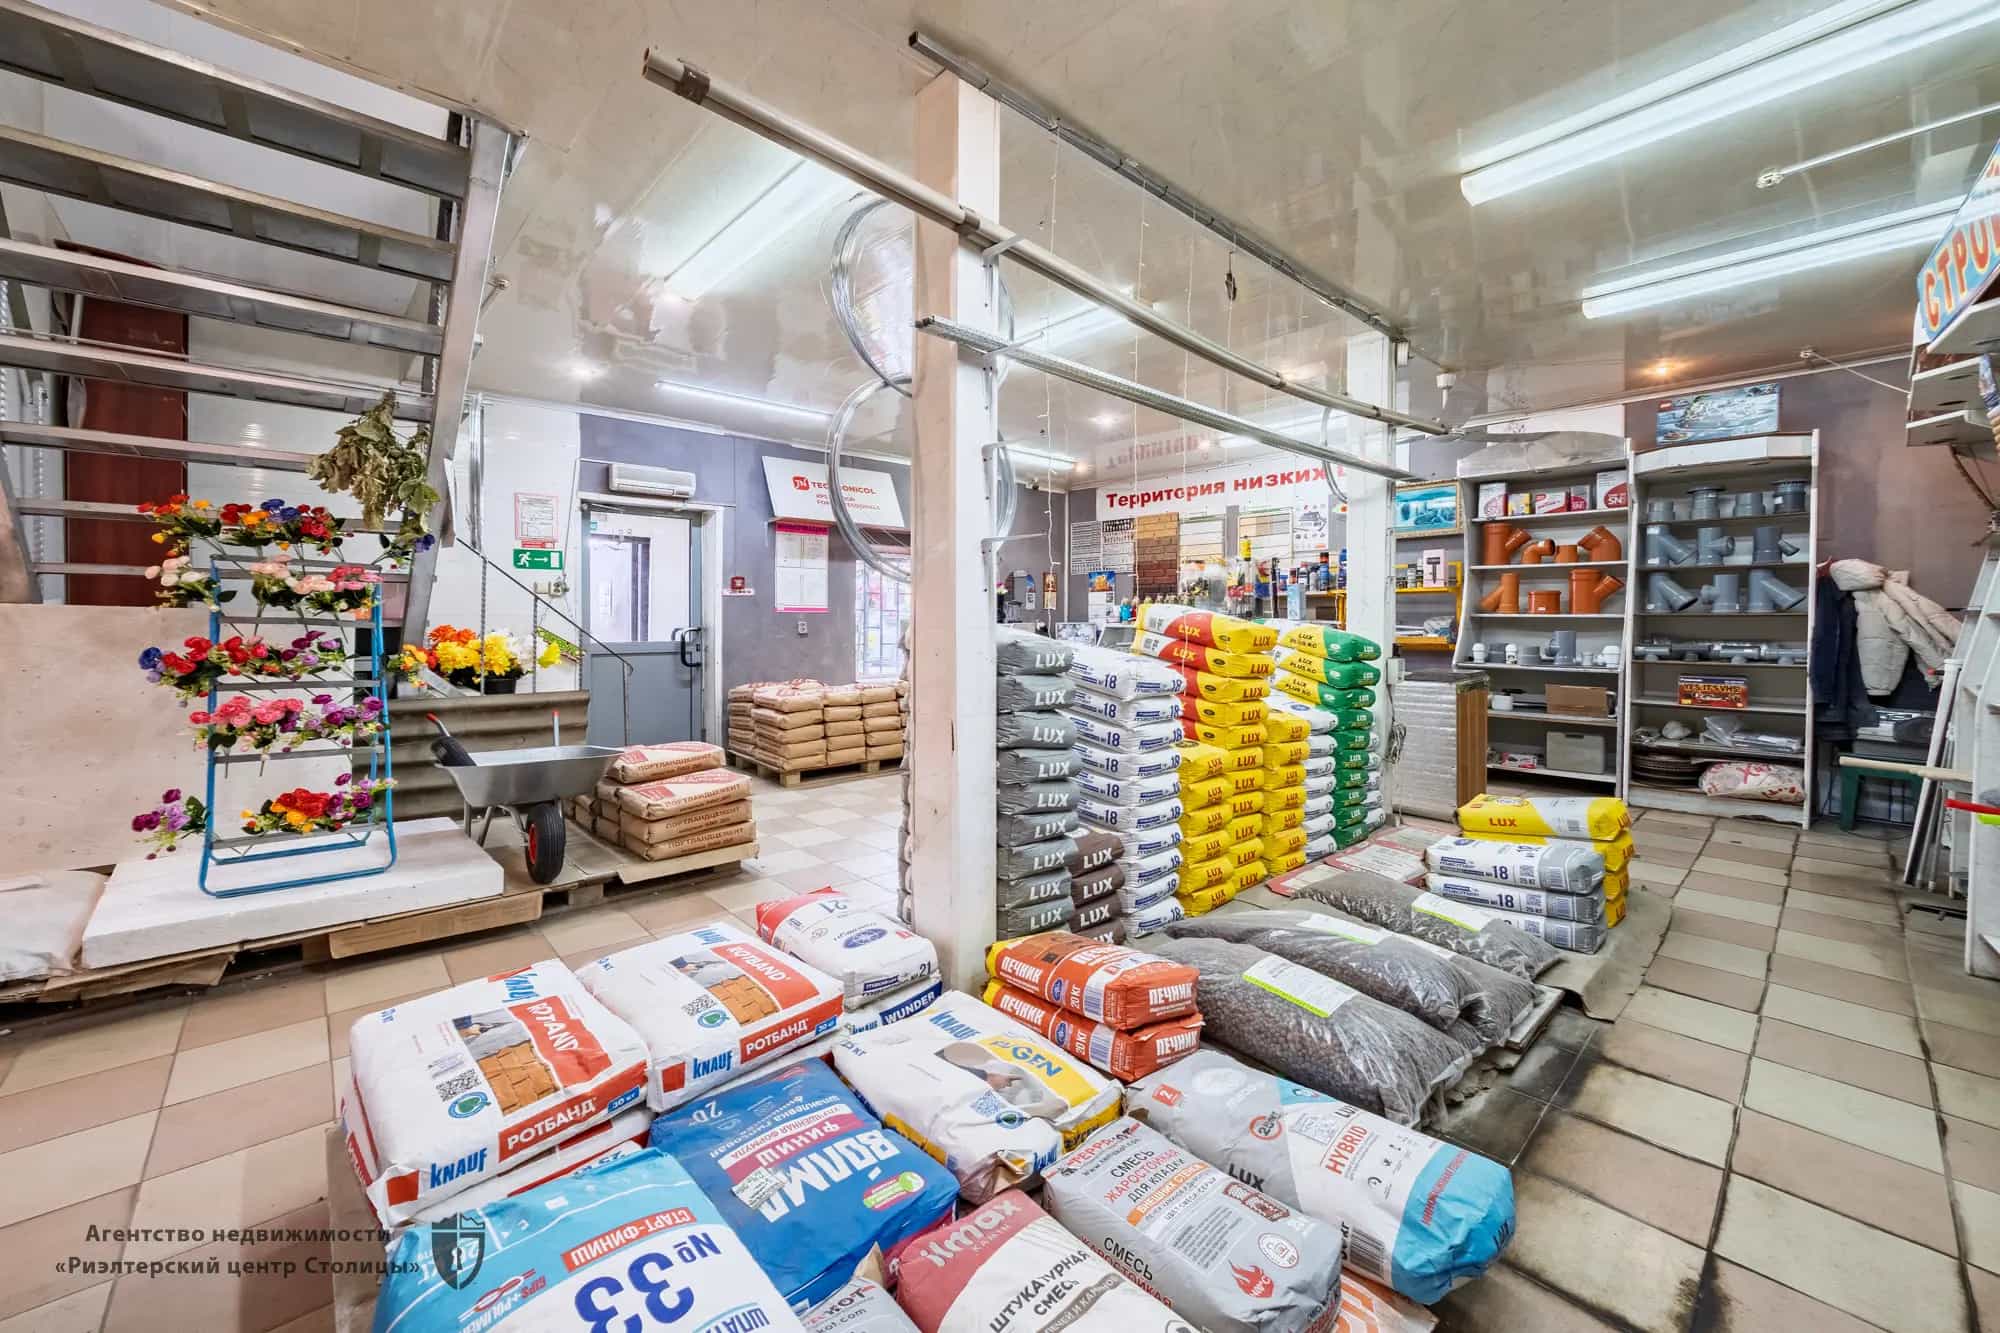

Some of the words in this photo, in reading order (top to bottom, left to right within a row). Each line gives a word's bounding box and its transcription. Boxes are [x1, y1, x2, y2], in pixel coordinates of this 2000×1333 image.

[811, 481, 877, 495] TECONICOL
[1106, 481, 1225, 509] Территория
[1233, 466, 1327, 491] низких
[1178, 624, 1200, 637] LUX
[1253, 636, 1271, 647] LUX
[1036, 652, 1066, 668] LUX
[1173, 648, 1196, 660] LUX
[1250, 664, 1269, 674] LUX
[1104, 674, 1117, 689] 18
[1035, 690, 1066, 706] LUX
[1243, 688, 1263, 698] LUX
[1103, 703, 1116, 718] 18
[1242, 709, 1260, 721] LUX
[1032, 726, 1065, 744] LUX
[1107, 732, 1120, 747] 18
[1241, 733, 1260, 744] LUX
[1038, 761, 1070, 778] LUX
[1106, 758, 1118, 772] 18
[1238, 756, 1256, 767] LUX
[1106, 784, 1120, 799] 18
[1235, 778, 1254, 790] LUX
[1038, 793, 1069, 808] LUX
[1233, 800, 1252, 813] LUX
[1105, 810, 1118, 824] 18
[1489, 817, 1518, 828] LUX
[1034, 819, 1066, 838] LUX
[1236, 825, 1254, 840] LUX
[1034, 851, 1066, 870] LUX
[1083, 848, 1112, 868] LUX
[1238, 850, 1256, 865] LUX
[1240, 873, 1258, 888] LUX
[1492, 865, 1508, 880] 18
[1030, 880, 1061, 900] LUX
[1083, 878, 1112, 899] LUX
[1496, 894, 1514, 908] 18
[1030, 908, 1062, 930] LUX
[1080, 904, 1110, 928] LUX
[920, 960, 931, 976] 21
[1000, 956, 1042, 983] ПЕЧНИК
[1148, 982, 1194, 1006] ПЕЧНИК
[885, 991, 935, 1023] WUNDER
[1000, 994, 1046, 1025] ПЕЧНИК
[745, 1020, 808, 1056] РОТБАНД
[1156, 1030, 1199, 1056] ПЕЧНИК
[692, 1050, 733, 1080] KNAUF
[507, 1102, 597, 1150] РОТБАНД
[756, 1121, 841, 1167] ФИНИШ
[1325, 1125, 1368, 1175] HYBRID
[429, 1147, 489, 1190] KNAUF
[1111, 1150, 1156, 1178] СМЕСЬ
[1228, 1163, 1266, 1192] LUX
[1128, 1183, 1150, 1203] ДЛЯ
[570, 1209, 691, 1267] СТАРТ-ФИНИШ
[920, 1200, 1022, 1268] ilmax
[672, 1232, 722, 1264] №
[1104, 1236, 1153, 1280] СМЕСЬ
[574, 1252, 695, 1333] 33
